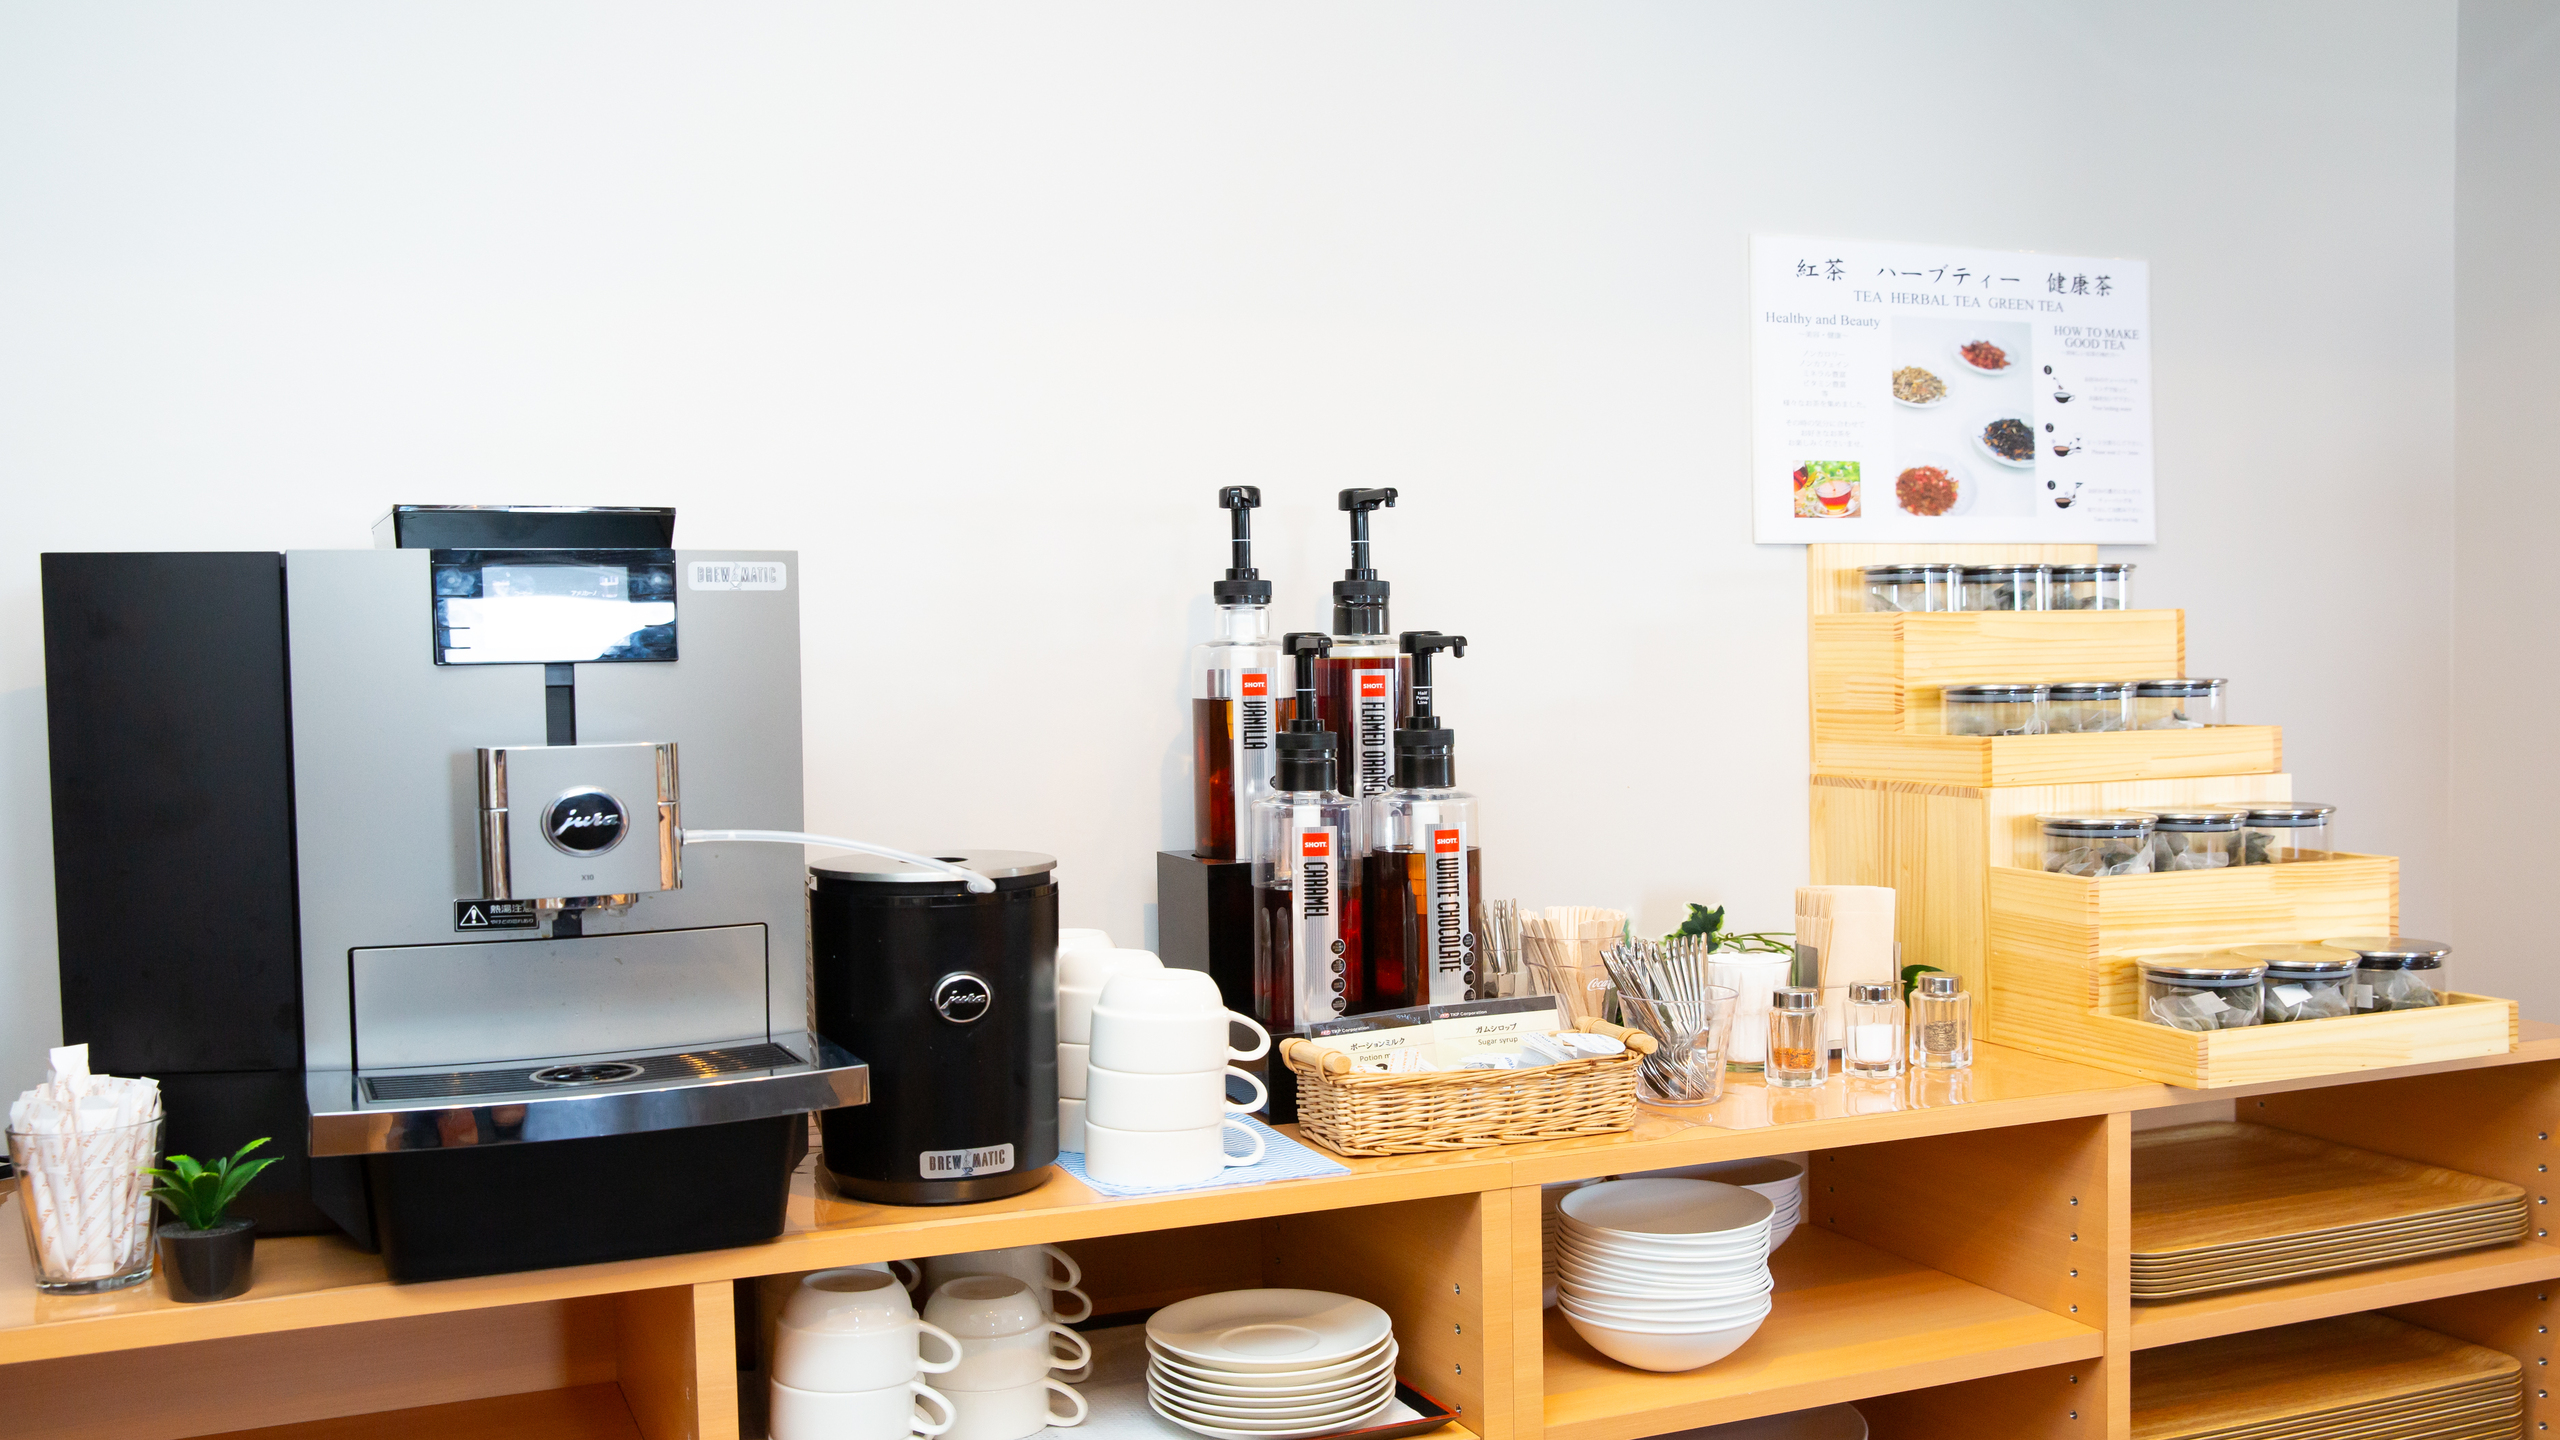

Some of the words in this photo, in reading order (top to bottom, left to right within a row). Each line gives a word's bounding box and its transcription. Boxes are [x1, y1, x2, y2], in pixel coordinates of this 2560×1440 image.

[1795, 258, 1846, 281] 紅茶
[1877, 264, 2021, 289] ハーブティー
[2046, 271, 2113, 297] 健康茶
[1854, 290, 1883, 303] TEA
[1890, 292, 1949, 307] HERBAL
[1953, 295, 1981, 308] TEA
[1988, 297, 2035, 311] GREEN
[2038, 300, 2064, 313] TEA
[1766, 311, 1812, 327] Healthy
[1815, 314, 1837, 325] and
[1840, 314, 1881, 330] Beauty
[2054, 325, 2082, 336] HOW
[2085, 327, 2102, 338] TO
[2105, 328, 2140, 340] MAKE
[2064, 338, 2100, 349] GOOD
[2102, 339, 2126, 350] TEA
[697, 566, 731, 583] BREW
[741, 566, 777, 583] MATIC
[1243, 701, 1268, 750] VANILLA
[1361, 702, 1385, 746] FLAMED
[553, 808, 621, 837] jura
[1436, 858, 1460, 898] WHITE
[1303, 861, 1329, 920] CARAMEL
[1437, 901, 1462, 973] CHOCOLATE
[939, 990, 986, 1010] jura
[1475, 1022, 1518, 1034] ガムシロップ
[1478, 1038, 1498, 1046] Sugar
[1499, 1037, 1519, 1045] syrup
[1359, 1053, 1383, 1062] Potion
[929, 1154, 962, 1171] BREW
[972, 1149, 1005, 1168] MATIC
